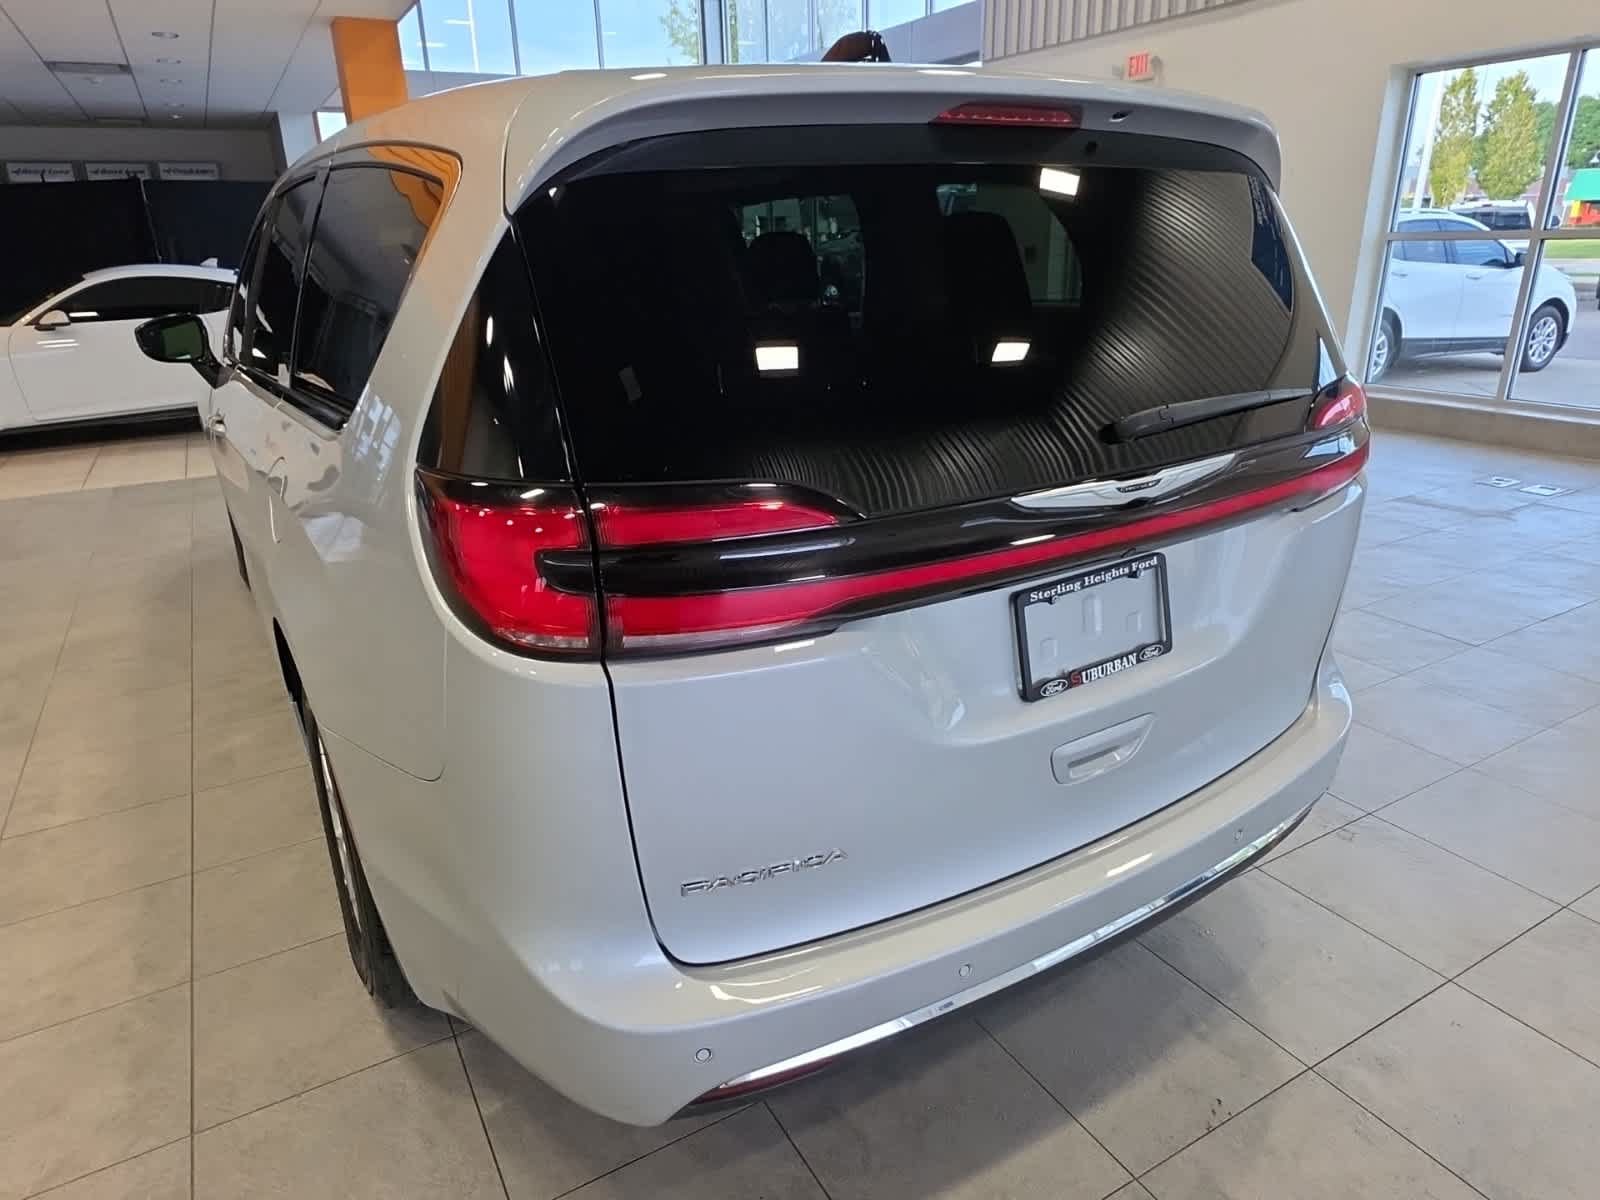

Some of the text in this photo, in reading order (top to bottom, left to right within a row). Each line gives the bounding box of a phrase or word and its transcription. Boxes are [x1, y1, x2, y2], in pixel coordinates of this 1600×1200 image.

[1128, 53, 1150, 77] EXIT
[1030, 556, 1158, 602] Sterling Heights Ford
[1071, 653, 1137, 687] SUBURBAN
[681, 848, 848, 897] PACIFICA
